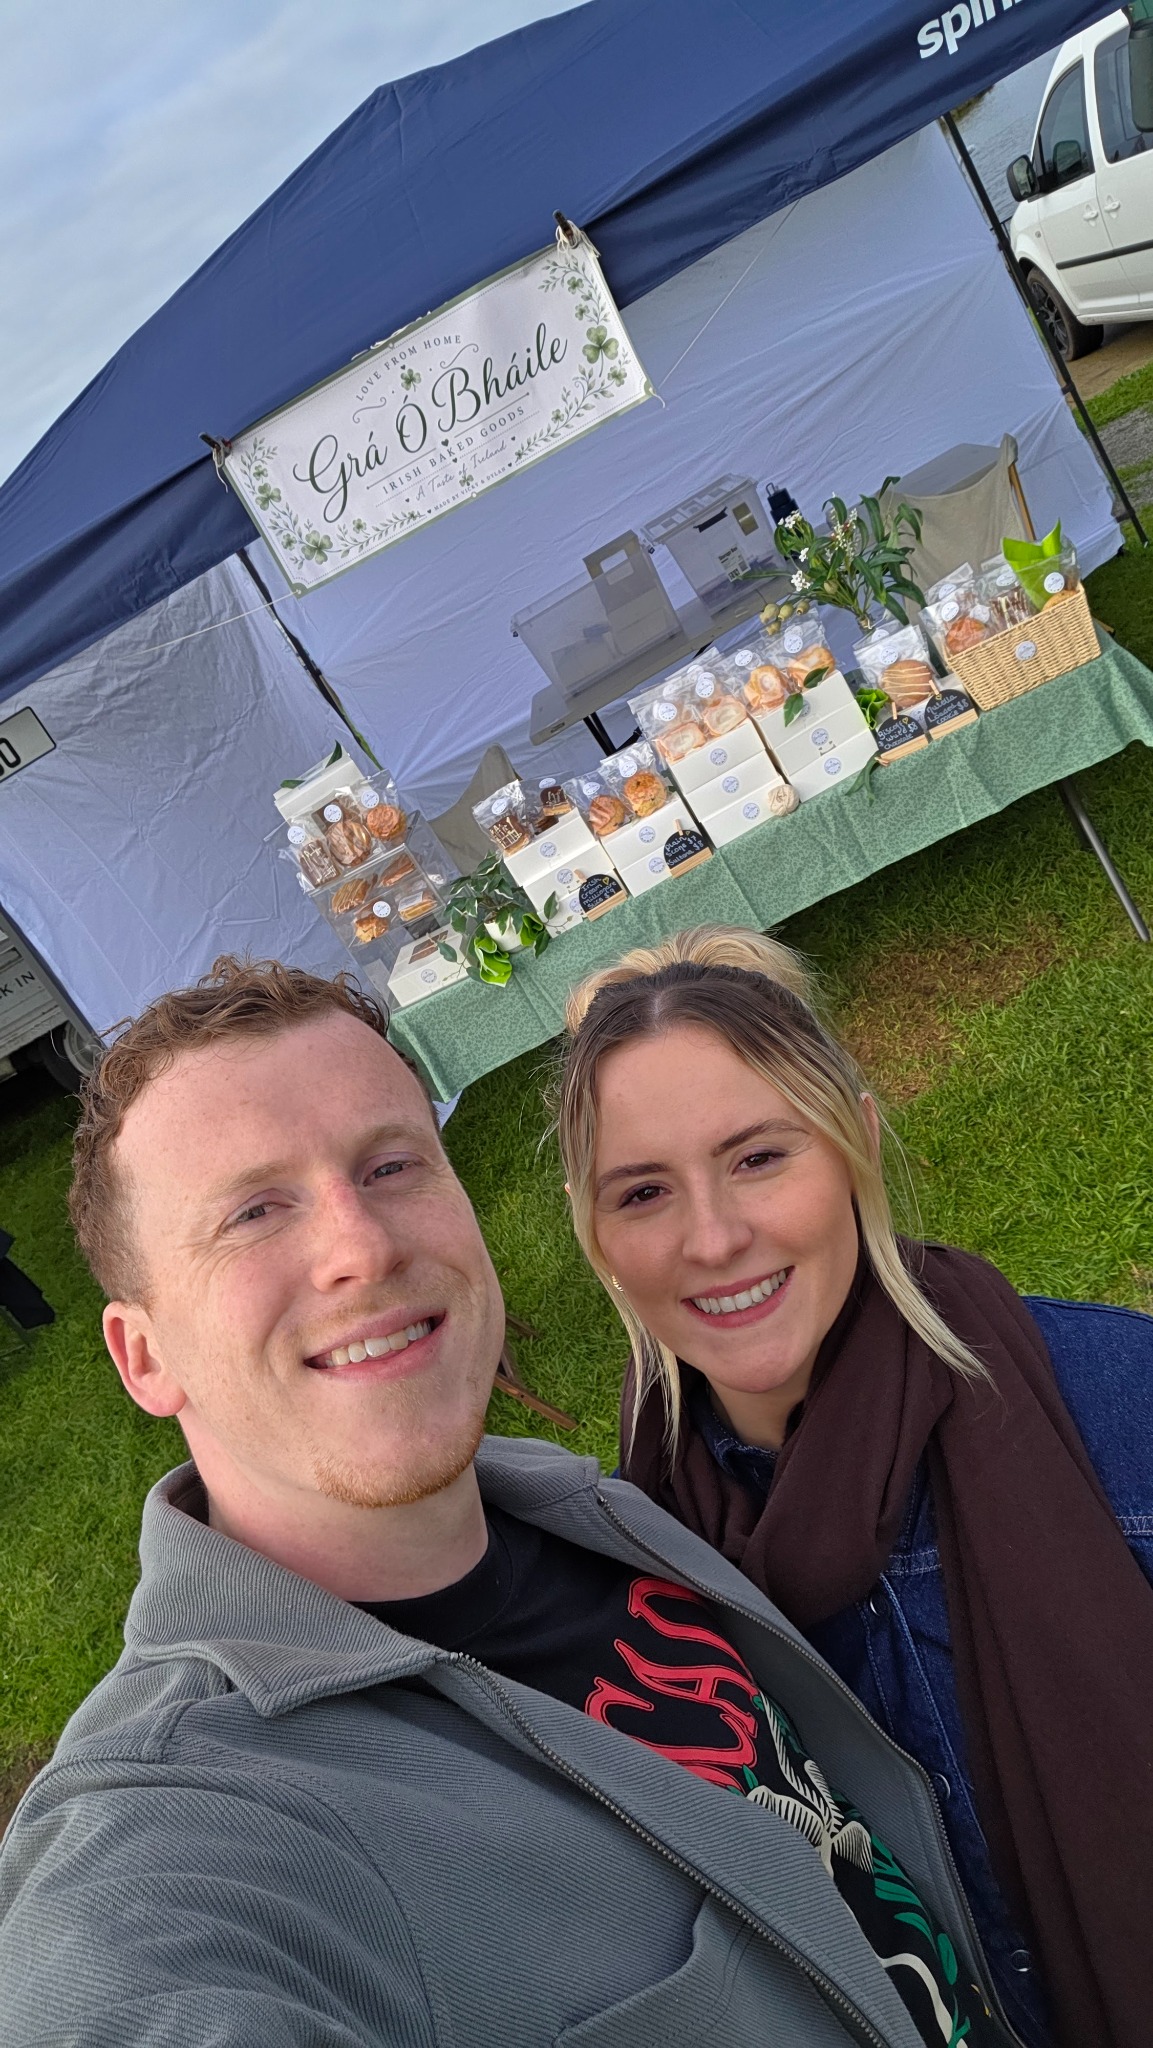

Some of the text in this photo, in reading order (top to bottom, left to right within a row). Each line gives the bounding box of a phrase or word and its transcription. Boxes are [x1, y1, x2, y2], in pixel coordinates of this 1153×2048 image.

[356, 335, 461, 401] LOVE FROM HOME
[293, 322, 568, 523] Grá Ó Bháile
[382, 406, 524, 494] IRISH BAKED GOODS
[415, 440, 507, 501] A Taste of Ireland
[434, 499, 450, 511] MADE
[452, 493, 460, 501] BY
[461, 482, 479, 495] VICKY
[486, 467, 506, 480] DYLAN
[581, 878, 602, 892] Irish
[15, 971, 35, 987] IN
